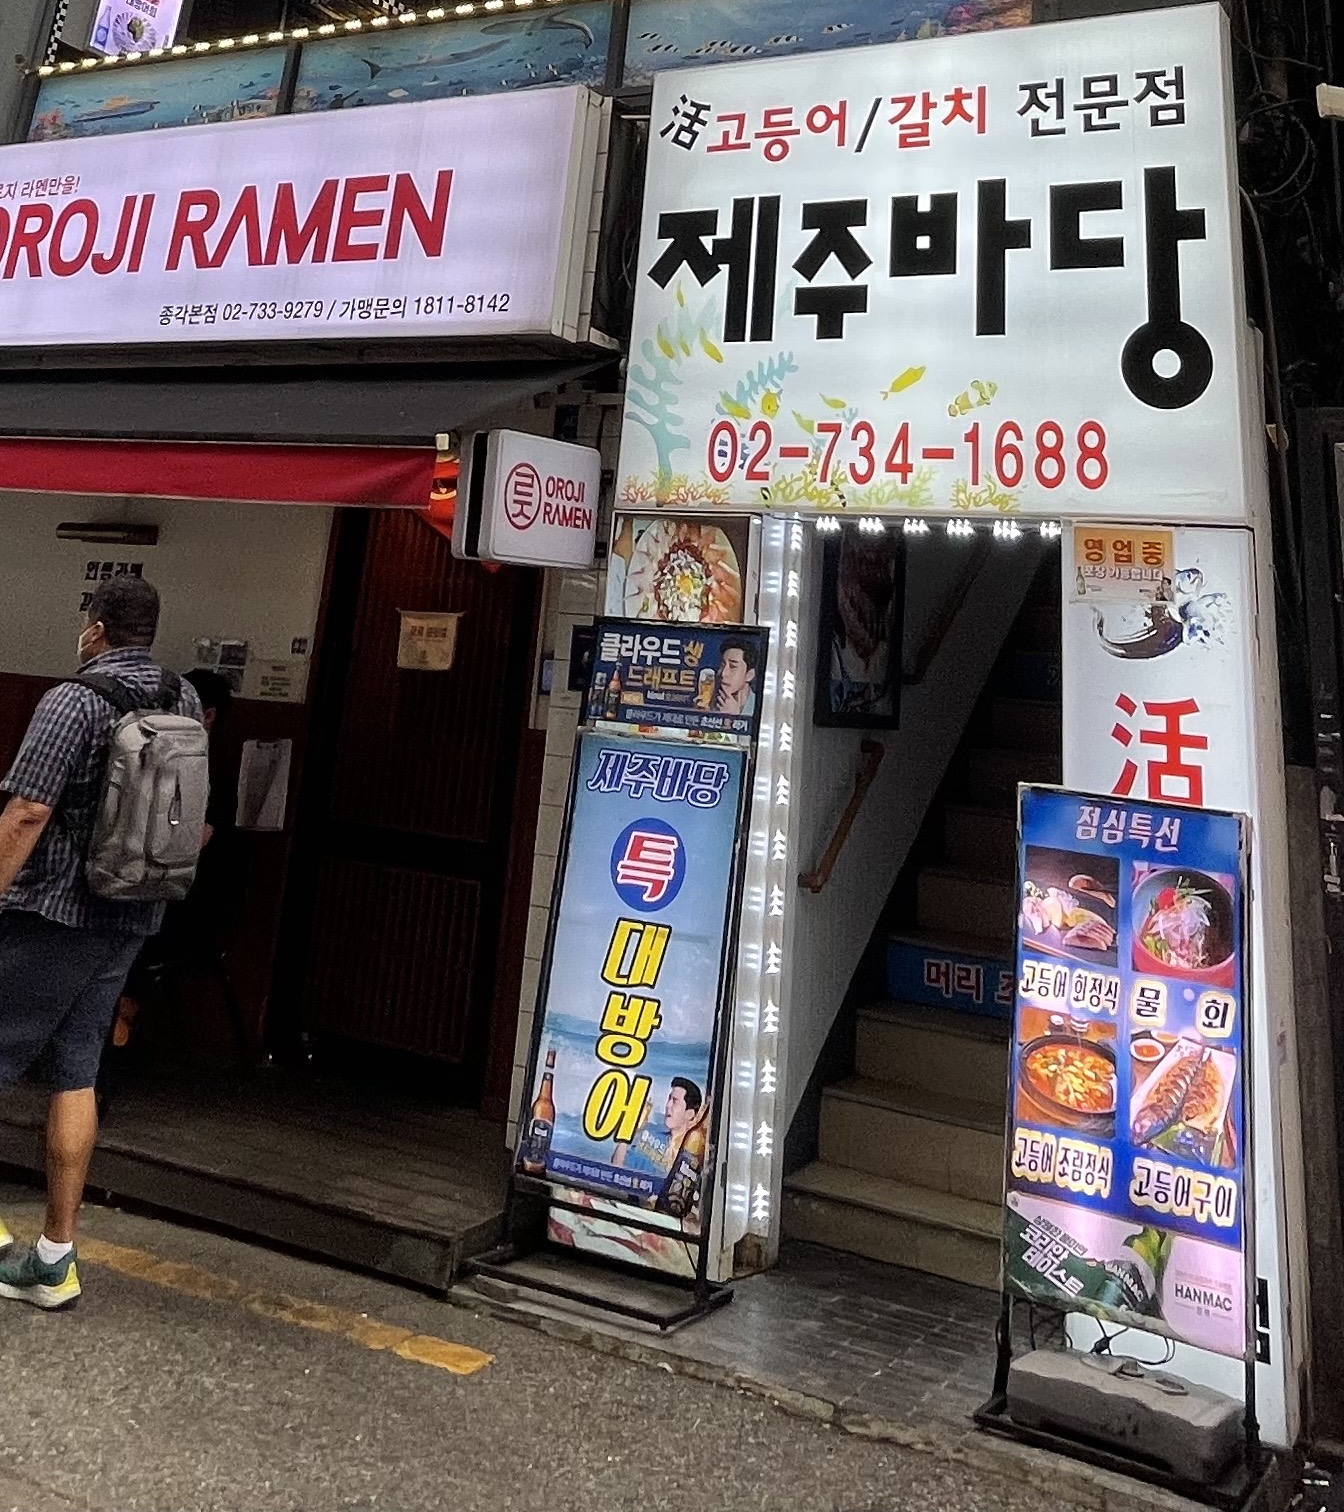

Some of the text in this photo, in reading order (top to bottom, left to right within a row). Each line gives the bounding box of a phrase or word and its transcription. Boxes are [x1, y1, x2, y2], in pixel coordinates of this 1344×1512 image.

[1016, 65, 1187, 140] 전문점
[164, 169, 454, 272] RAMEN
[159, 303, 218, 326] 종각본점
[222, 301, 323, 322] 02-733-9279
[338, 296, 407, 321] 가맹문의
[414, 293, 511, 316] 1811-8142
[647, 165, 1214, 410] 제주바당
[707, 419, 1110, 490] 02-734-1688
[545, 475, 586, 502] OROJI
[543, 506, 592, 531] RAMEN
[1083, 538, 1164, 566] 영업중
[601, 632, 681, 665] 클라우드
[626, 665, 696, 692] 드래프트
[1111, 692, 1208, 808] 活
[587, 749, 729, 808] 제주바당
[1076, 804, 1181, 852] 점심특선
[616, 831, 679, 903] 특
[925, 960, 983, 1004] 머리
[1020, 963, 1119, 1013] 고등어 회정식
[583, 917, 673, 1144] 대방어
[1013, 1133, 1112, 1190] 고등어 조림정식
[1133, 1162, 1233, 1219] 고등어구이
[1019, 1224, 1070, 1265] 코리안
[1021, 1246, 1085, 1298] 테이스트
[1174, 1283, 1234, 1312] HANMAC
